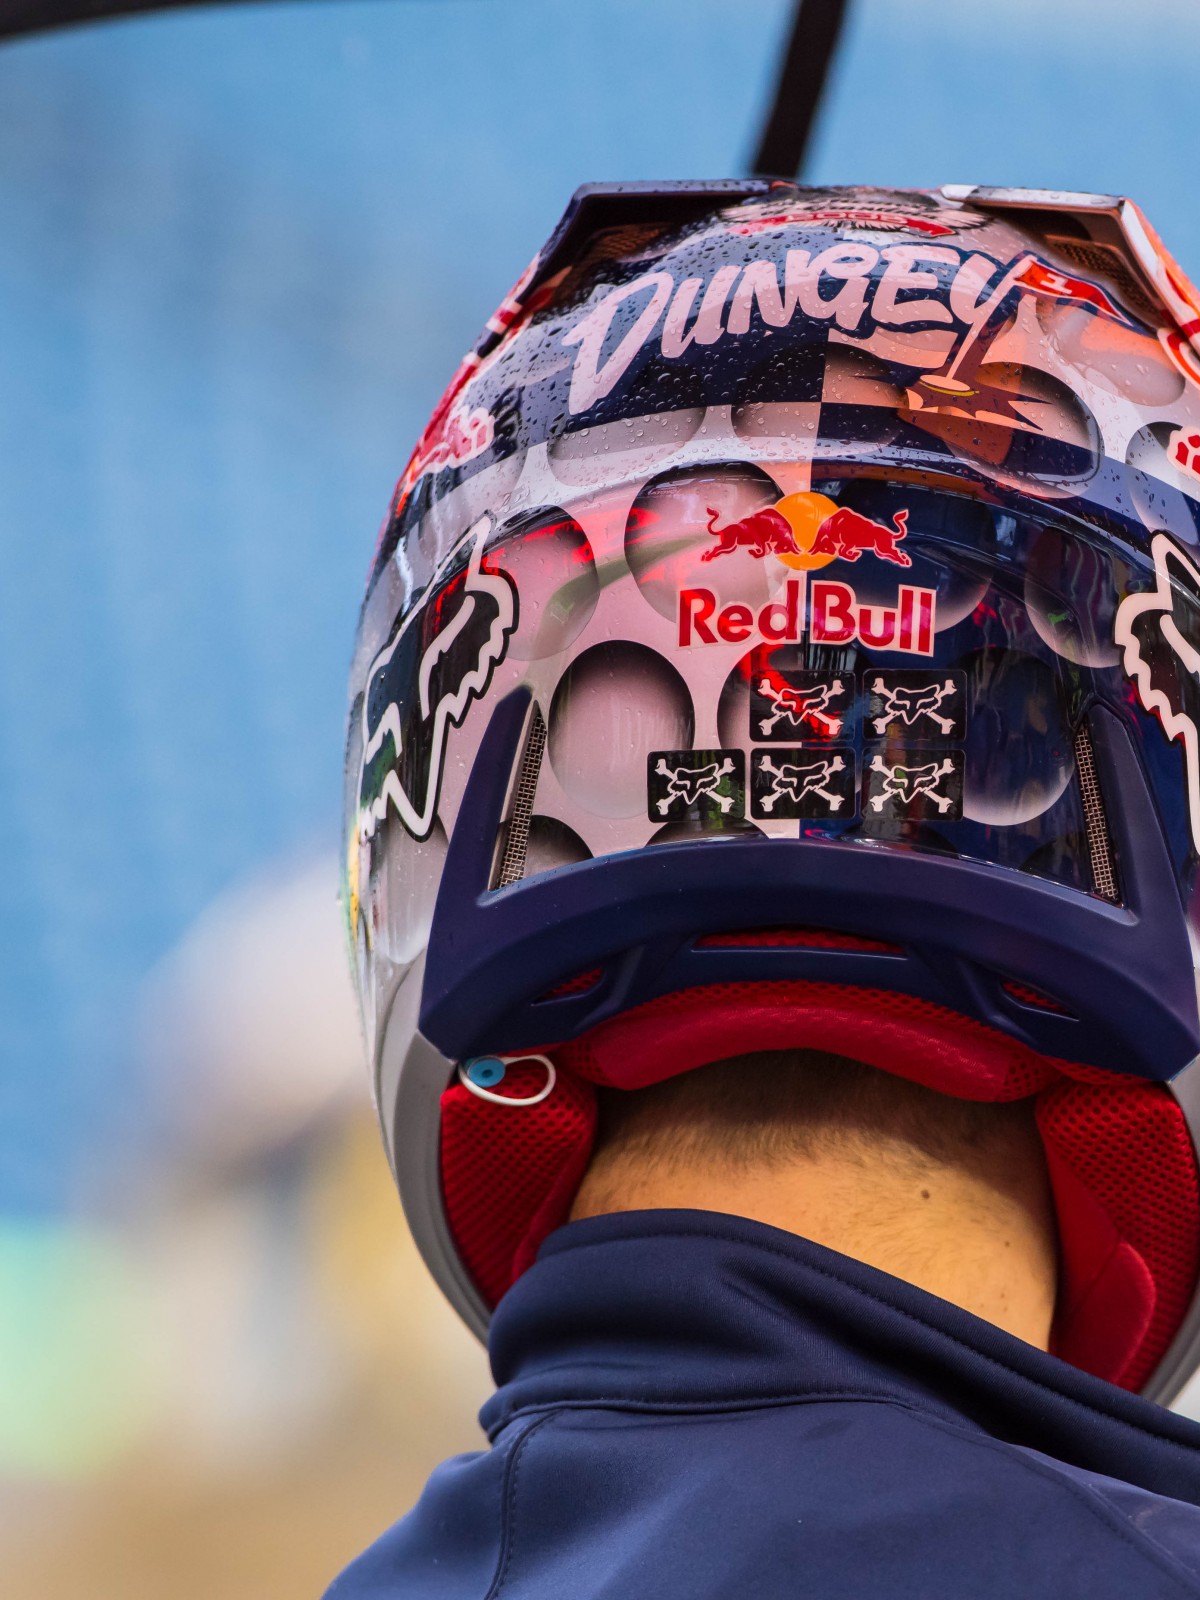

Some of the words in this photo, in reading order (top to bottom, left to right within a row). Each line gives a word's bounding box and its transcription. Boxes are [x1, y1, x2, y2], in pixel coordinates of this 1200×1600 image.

[561, 243, 1036, 416] DUNGEY
[676, 578, 801, 648] Red
[811, 581, 936, 656] Bull
